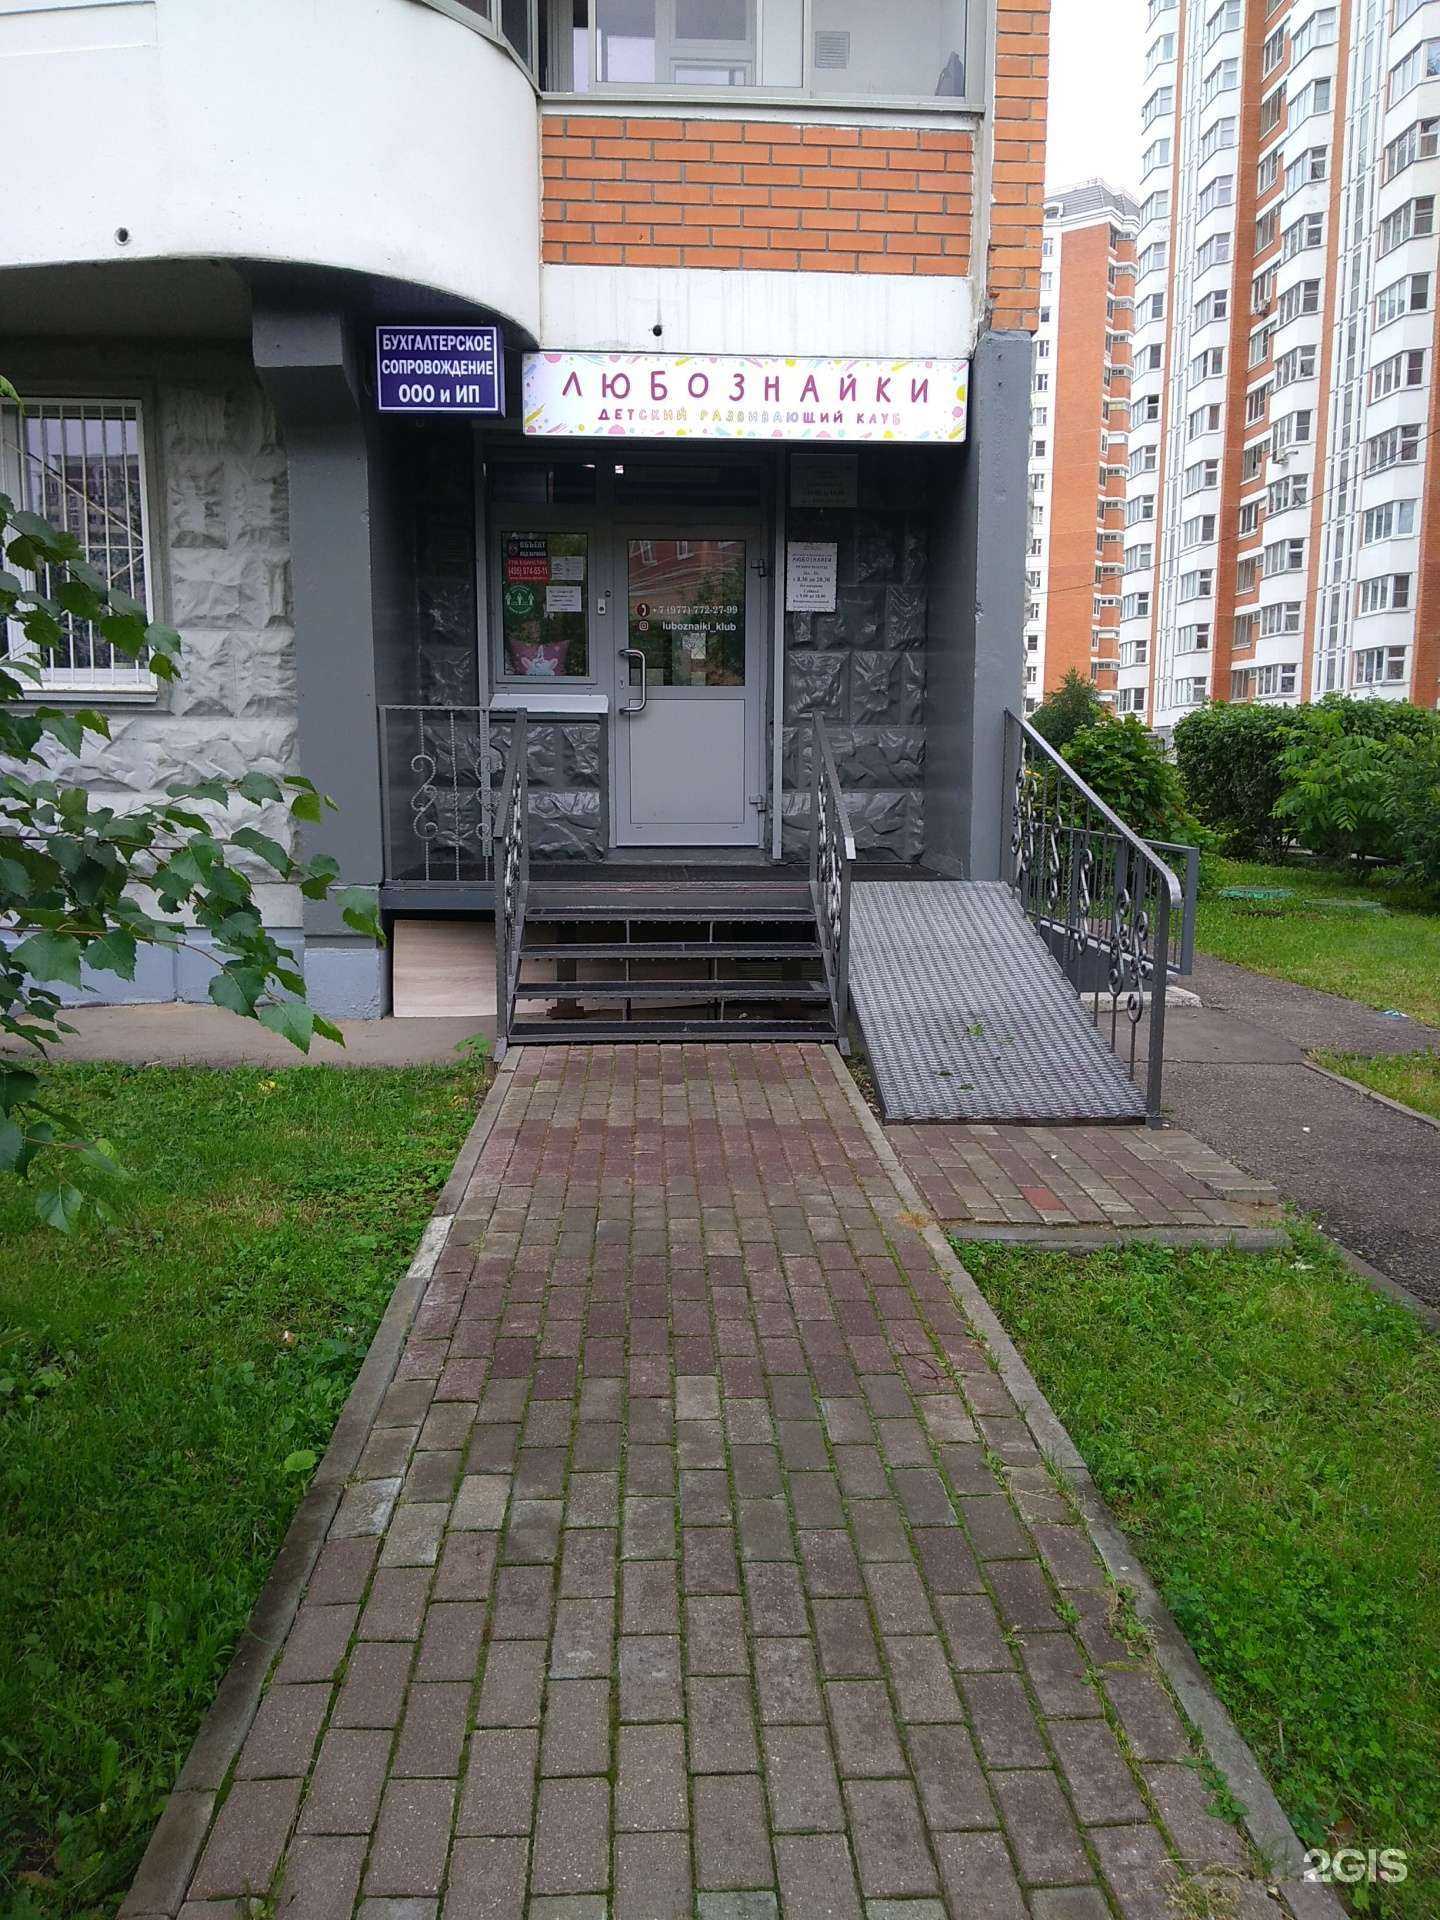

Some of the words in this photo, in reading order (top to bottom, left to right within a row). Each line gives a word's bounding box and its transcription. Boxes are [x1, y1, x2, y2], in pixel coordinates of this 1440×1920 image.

[382, 334, 493, 352] БУХГАЛТЕРСКОЕ
[381, 359, 494, 377] СОПРОВОЖДЕНИЕ
[398, 384, 435, 403] ООО
[440, 388, 451, 403] и
[455, 384, 480, 404] ИП
[561, 370, 930, 403] ЛЮБОЗНАЙКИ
[598, 406, 687, 422] ДЕТСКИЙ
[700, 408, 844, 425] РАЗВИВАЮЩИЙ
[856, 411, 901, 426] КЛУБ
